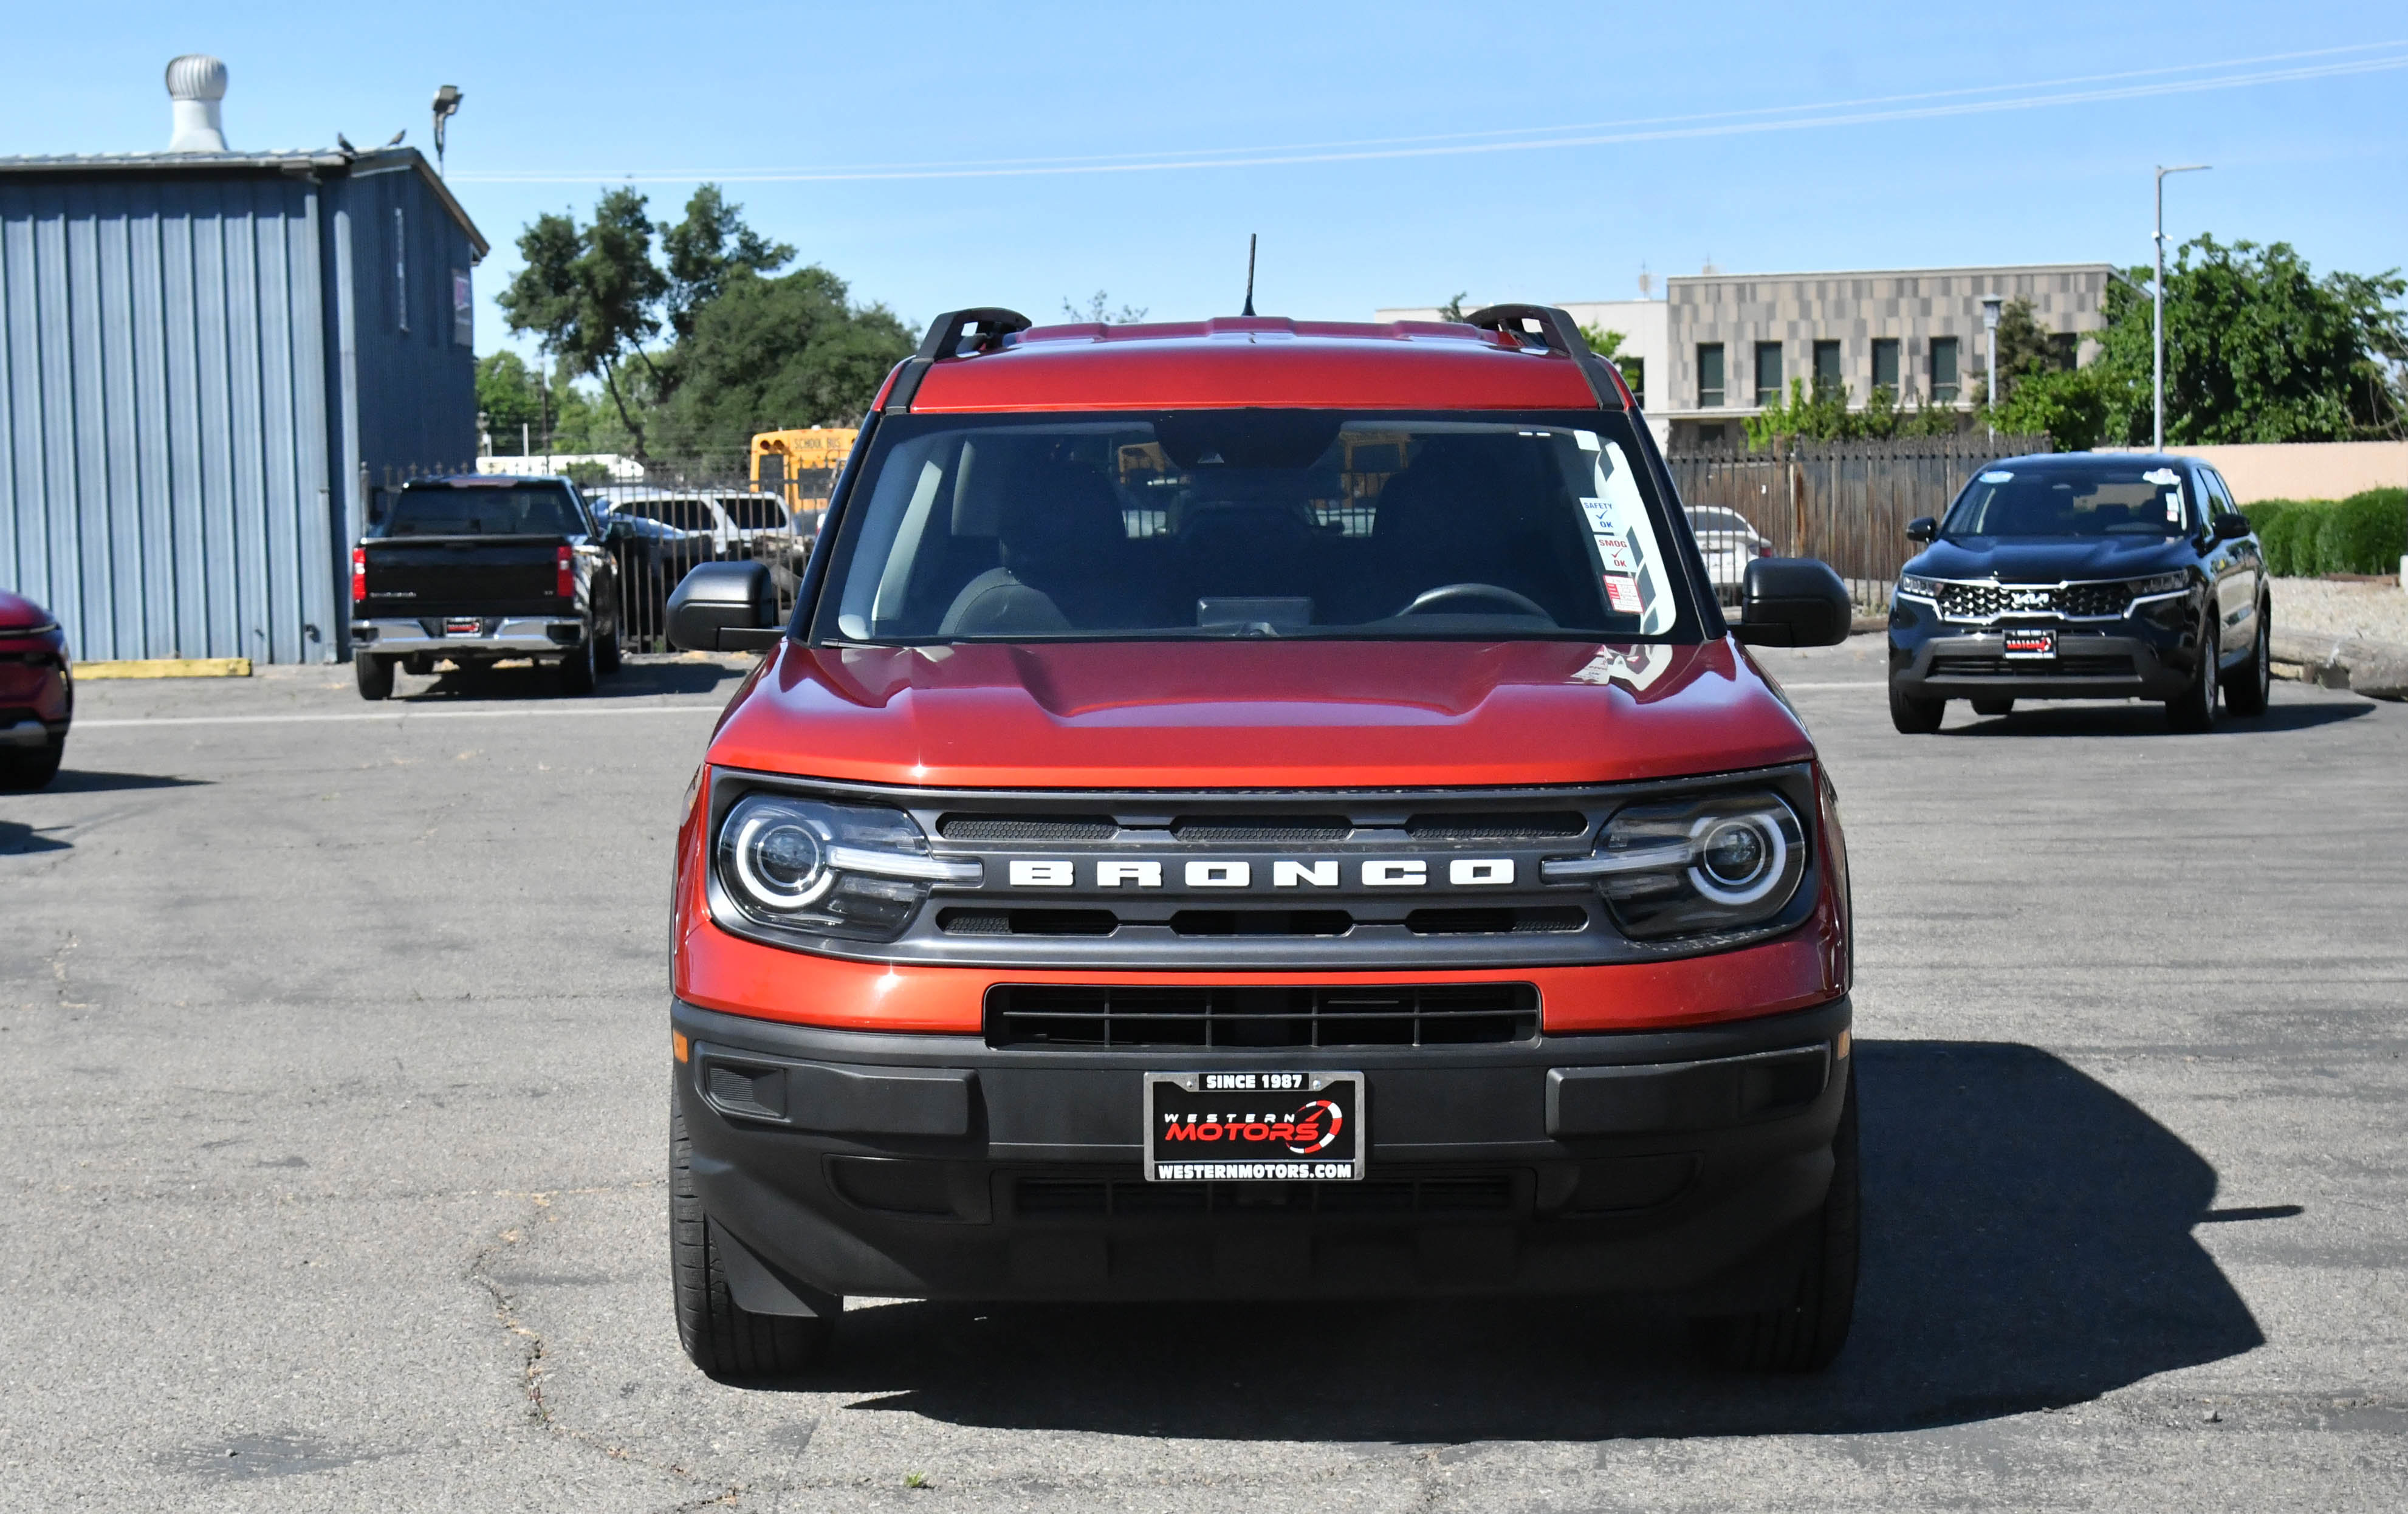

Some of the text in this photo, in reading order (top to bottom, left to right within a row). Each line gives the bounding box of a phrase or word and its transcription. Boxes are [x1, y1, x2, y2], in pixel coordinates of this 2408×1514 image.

[794, 437, 840, 449] SCHOOL BUS
[1583, 502, 1613, 510] SAFETY
[1599, 539, 1627, 548] SMOG
[1613, 559, 1627, 567] OK
[1009, 858, 1515, 887] BRONCO
[1206, 1074, 1303, 1089] SINCE 1987
[1164, 1114, 1295, 1123] WESTERN
[1165, 1122, 1320, 1142] MOTORS
[1158, 1164, 1352, 1180] WESTERNMOTORS.COM
